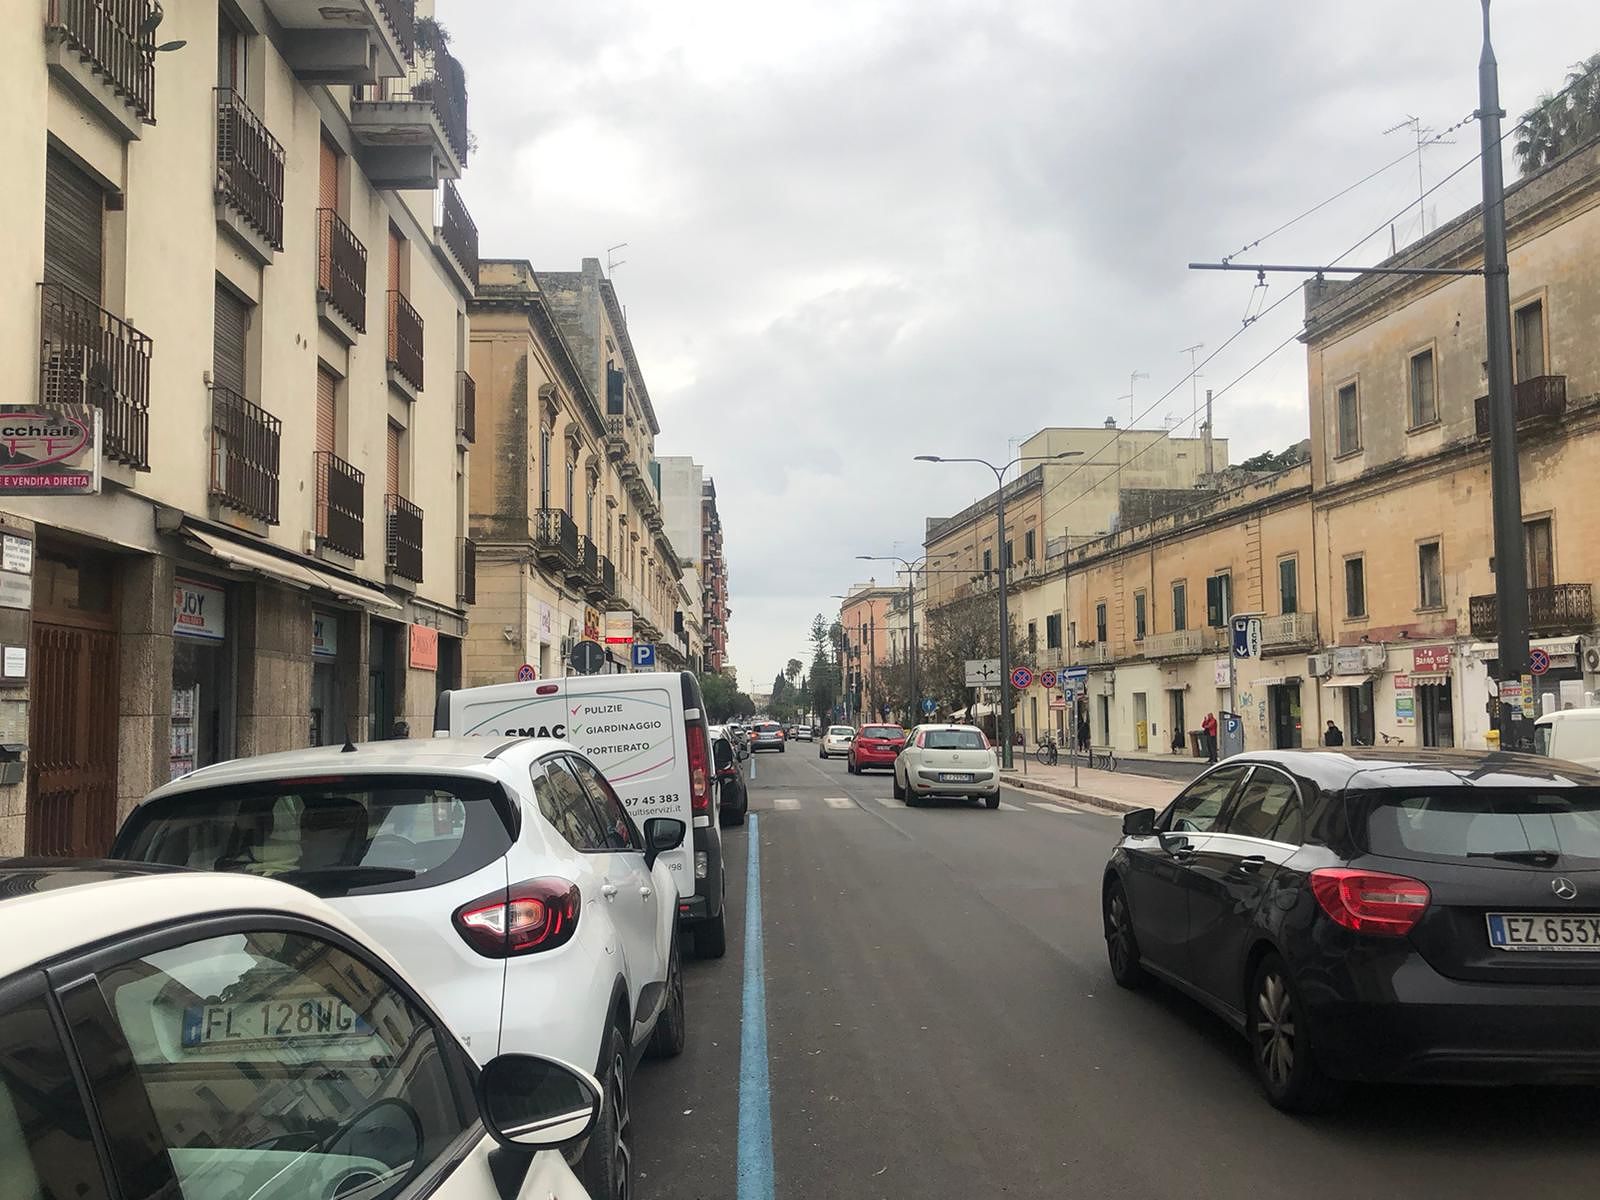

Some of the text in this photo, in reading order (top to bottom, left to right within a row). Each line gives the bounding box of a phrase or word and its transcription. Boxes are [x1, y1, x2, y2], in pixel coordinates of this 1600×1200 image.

[4, 476, 10, 486] E
[12, 476, 51, 486] VENDITA
[53, 476, 88, 486] DIRETTA
[182, 591, 205, 616] JOY
[638, 646, 651, 664] P
[584, 704, 624, 715] PULIZIE
[504, 724, 566, 740] SMAC
[585, 720, 662, 735] GIARDINAGGIO
[1228, 720, 1236, 731] P
[586, 742, 650, 756] PORTIERATO
[625, 793, 679, 807] 97 45 383
[1506, 918, 1538, 943] EZ
[204, 1000, 352, 1040] FL 128WG
